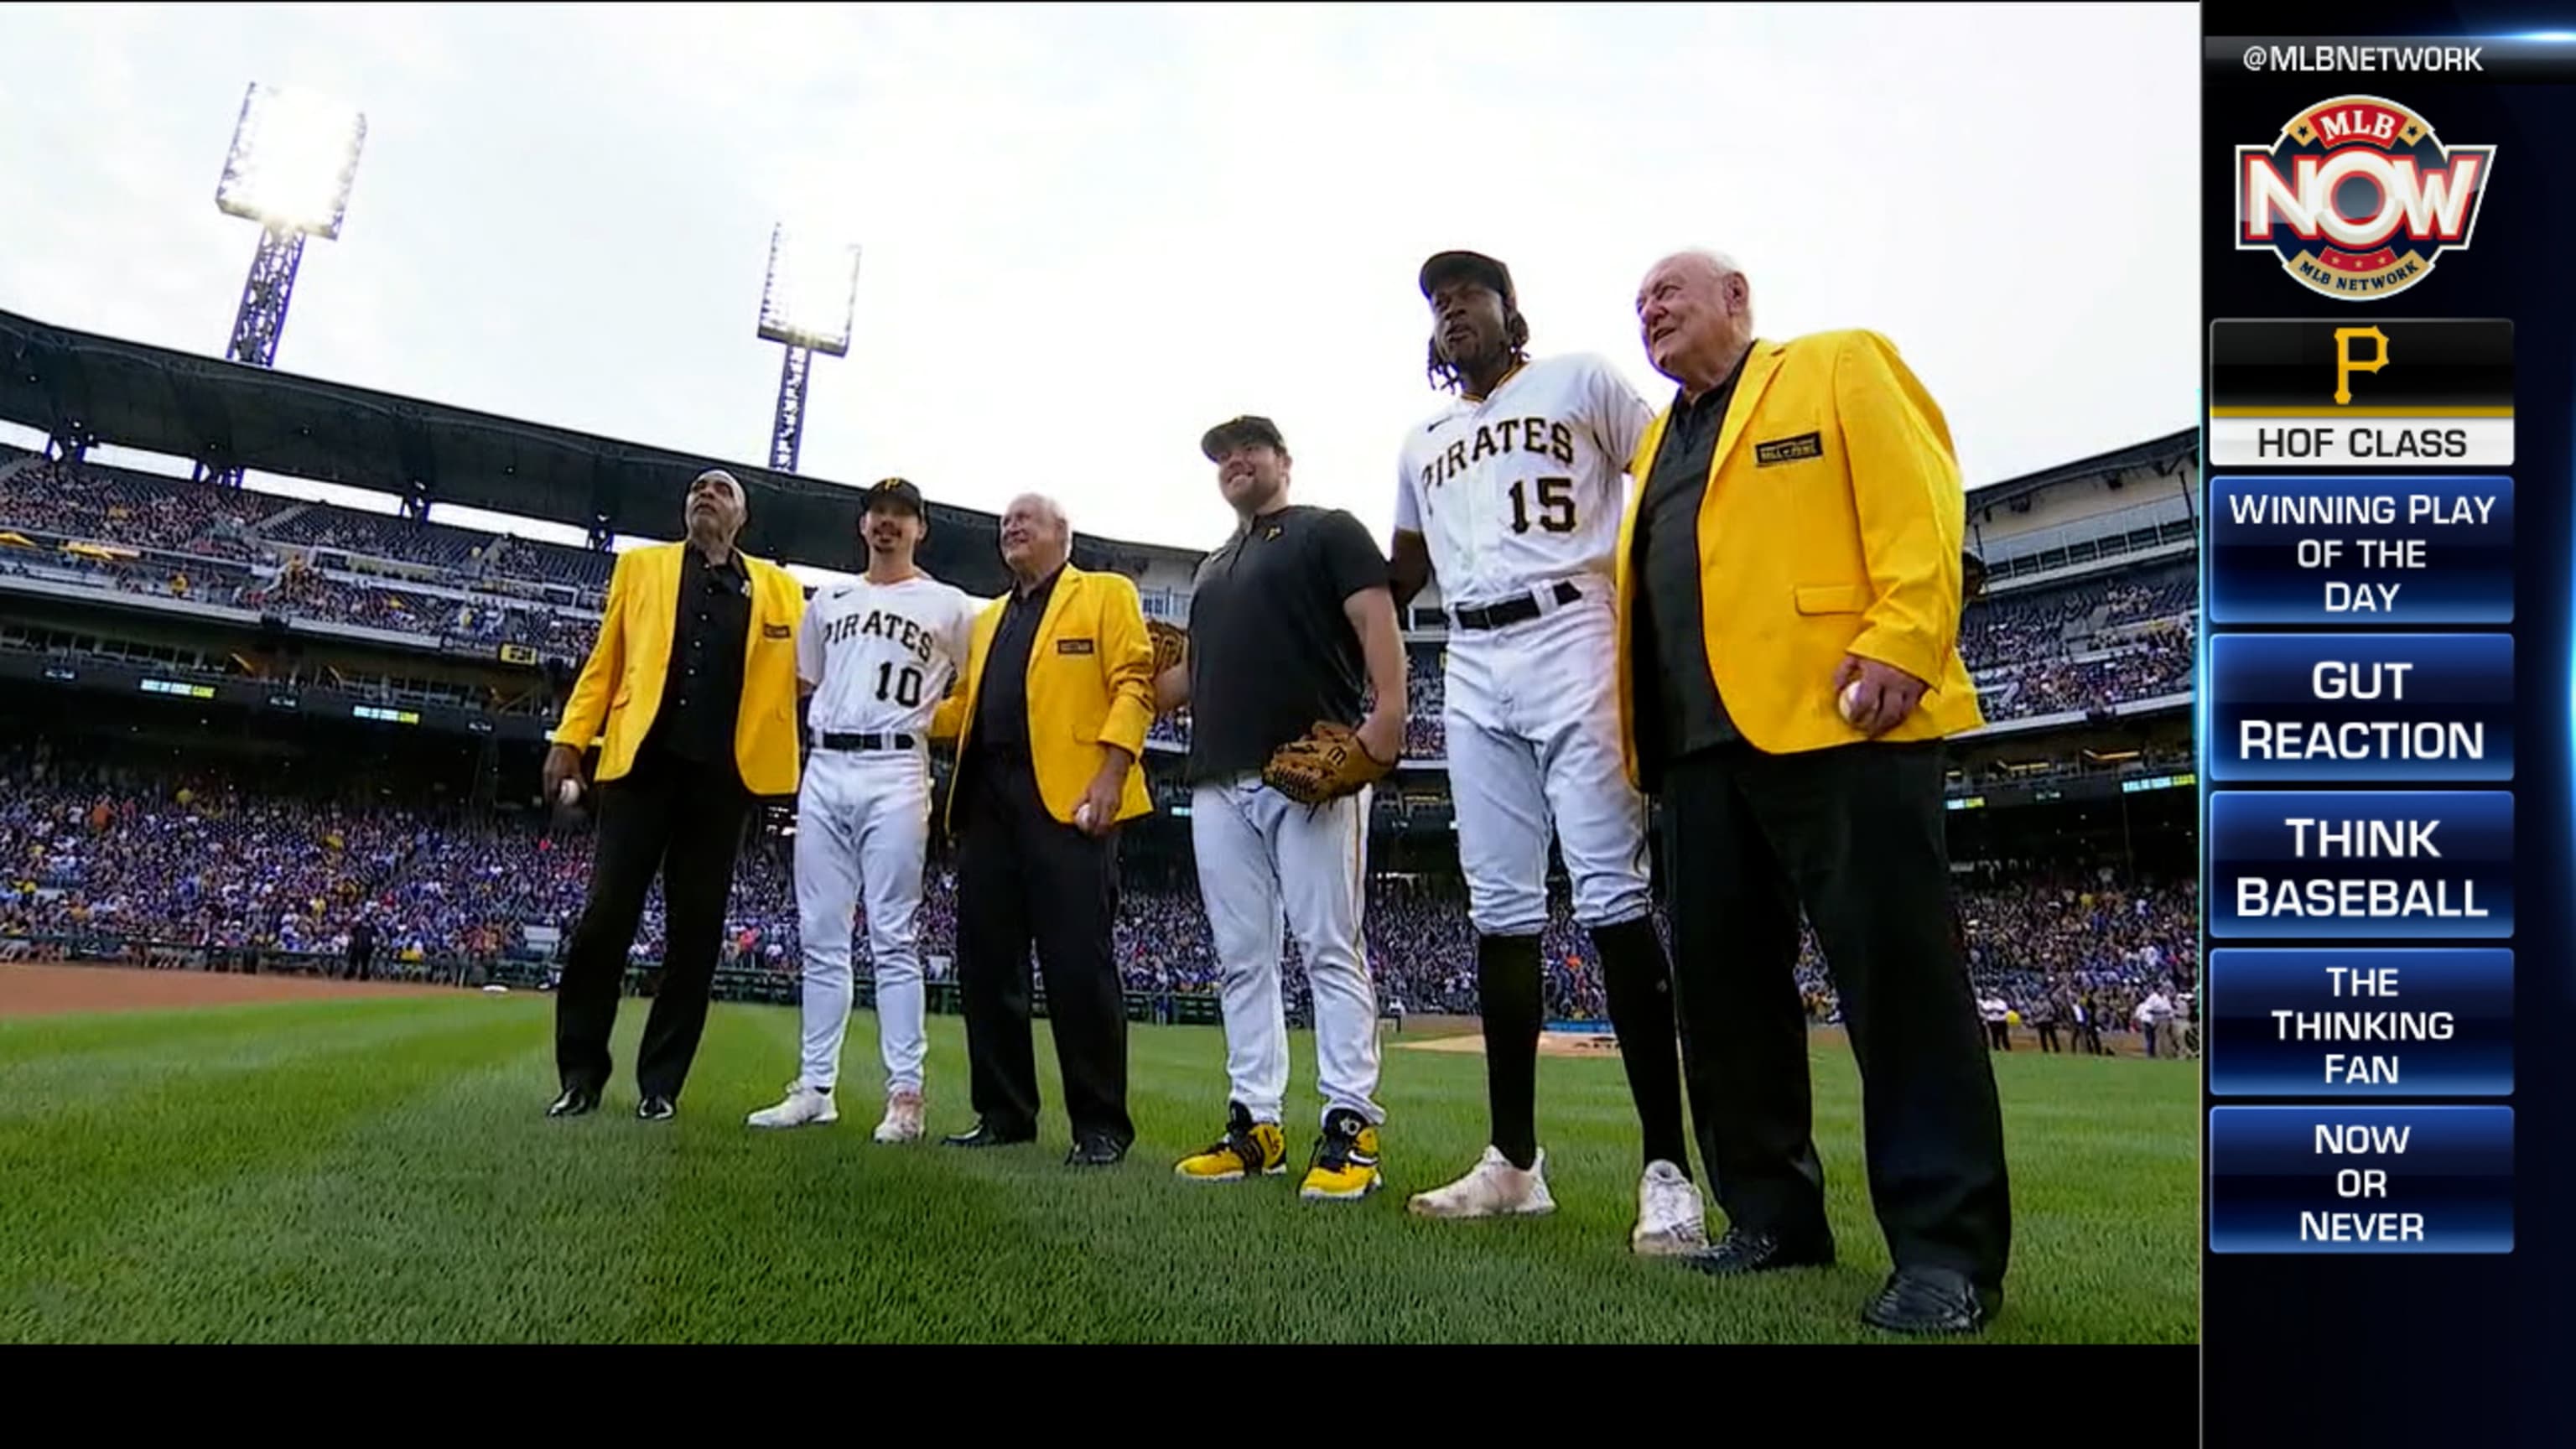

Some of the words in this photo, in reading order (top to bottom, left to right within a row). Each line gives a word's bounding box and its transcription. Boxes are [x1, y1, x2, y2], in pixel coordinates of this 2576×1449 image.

[1420, 418, 1574, 487] PIRATES
[1508, 476, 1577, 534] 15
[875, 661, 923, 709] 10
